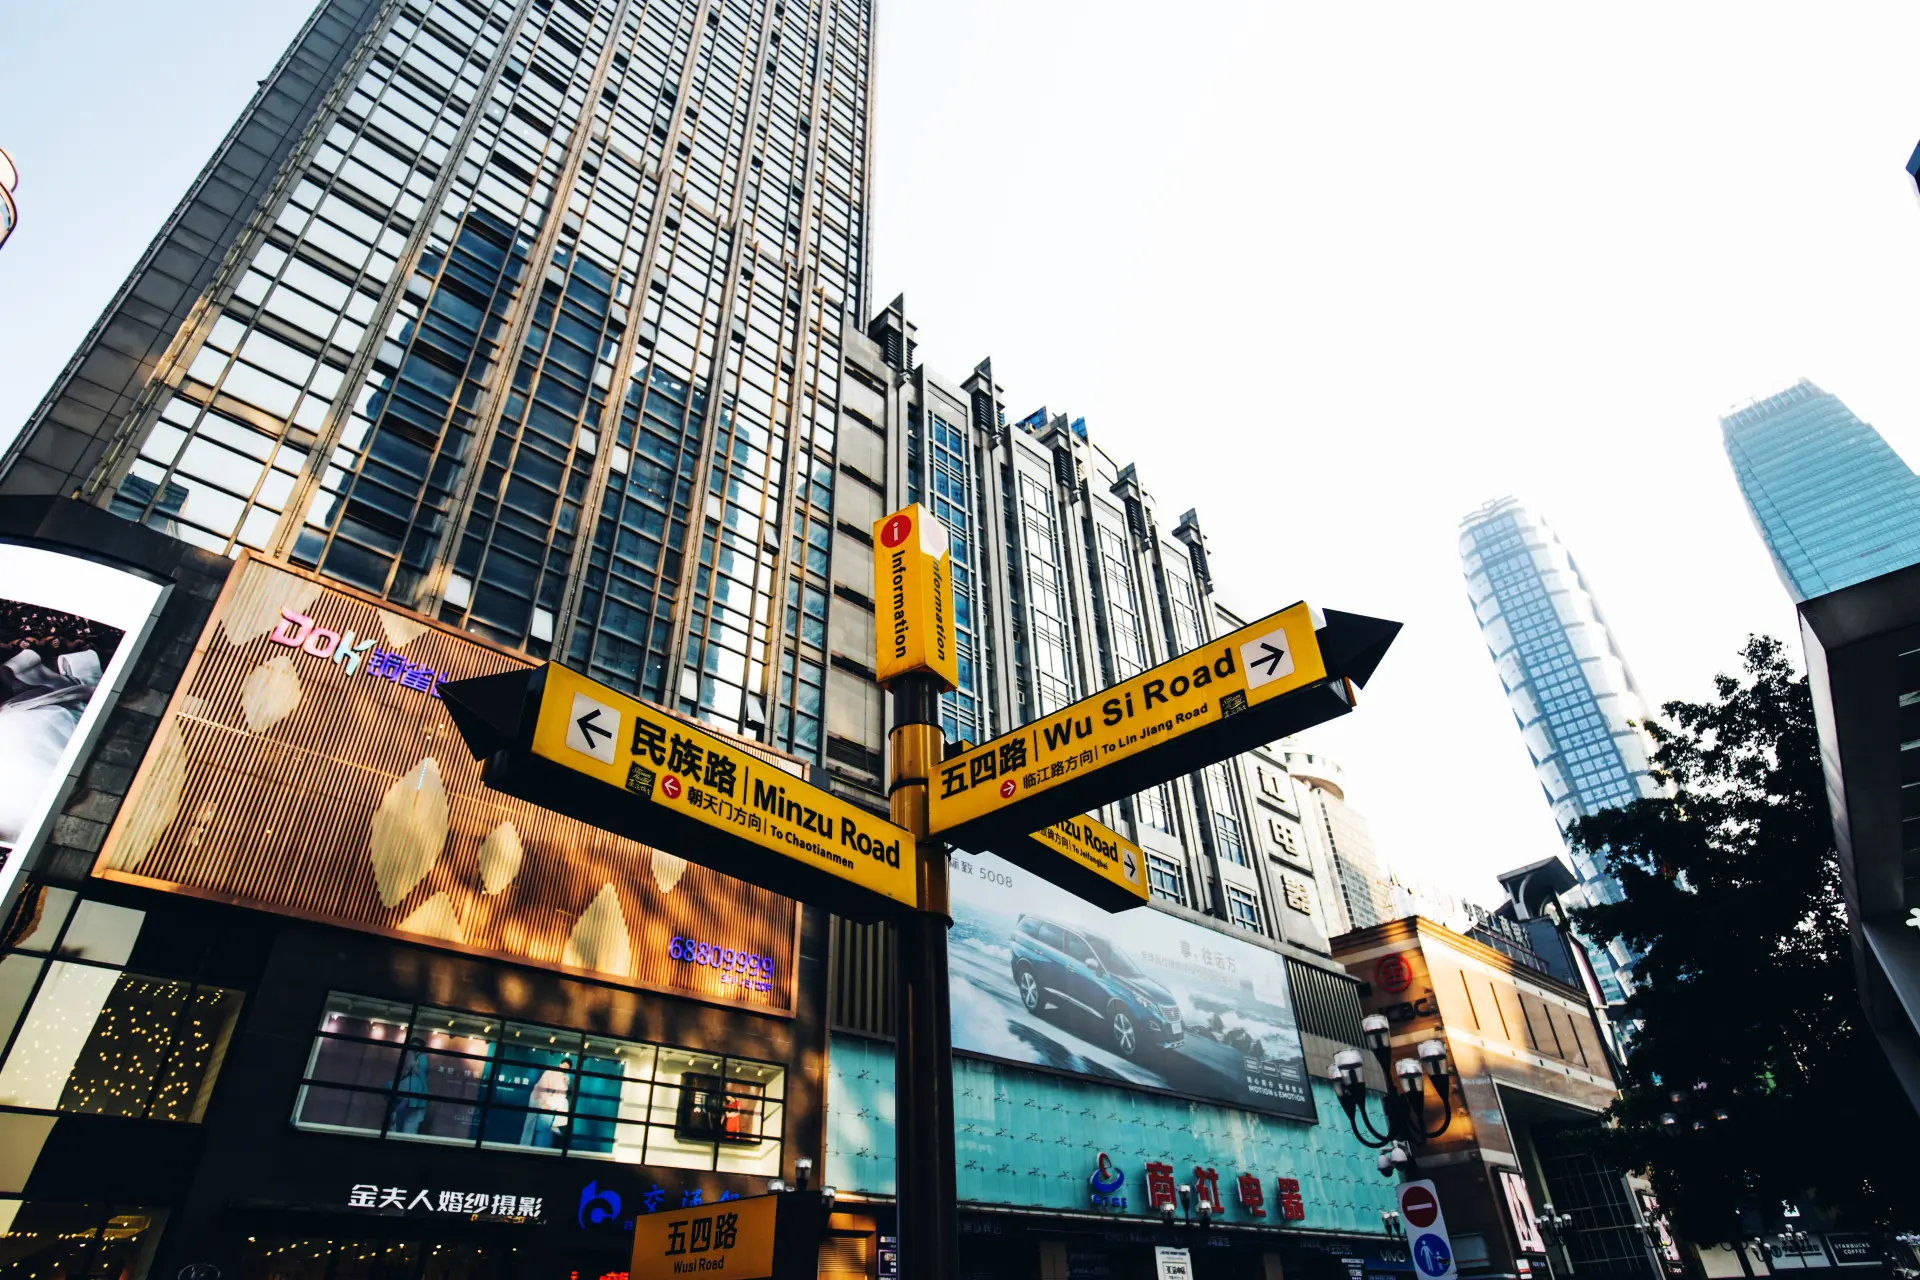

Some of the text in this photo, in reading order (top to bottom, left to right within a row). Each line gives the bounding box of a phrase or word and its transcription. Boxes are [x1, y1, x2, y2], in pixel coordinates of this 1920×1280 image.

[892, 550, 909, 658] Information
[1043, 718, 1093, 752] Wu
[1102, 692, 1135, 726] Si
[1145, 647, 1236, 710] Road
[1101, 742, 1116, 754] To
[1118, 733, 1139, 748] Lin
[1139, 718, 1173, 741] Jiang
[1176, 703, 1209, 725] Road
[631, 716, 737, 798] 民族路
[940, 737, 1028, 800] 五四路
[1022, 749, 1094, 790] 临江路方向
[686, 786, 762, 832] 朝天门方向
[753, 778, 900, 870] Minzu Road
[770, 824, 854, 870] To Chaotianmen
[1055, 820, 1118, 863] nzu Road
[1072, 844, 1079, 854] To
[980, 867, 1013, 888] 5008
[669, 936, 774, 979] 68809999
[1248, 1085, 1273, 1096] MOTION
[1278, 1091, 1306, 1102] EMOTION
[348, 1183, 543, 1218] 金夫人婚纱摄影
[1144, 1161, 1305, 1221] 商社电器
[665, 1211, 738, 1256] 五四路
[1834, 1242, 1870, 1250] STARBUCKS
[674, 1255, 724, 1275] Wusi Road
